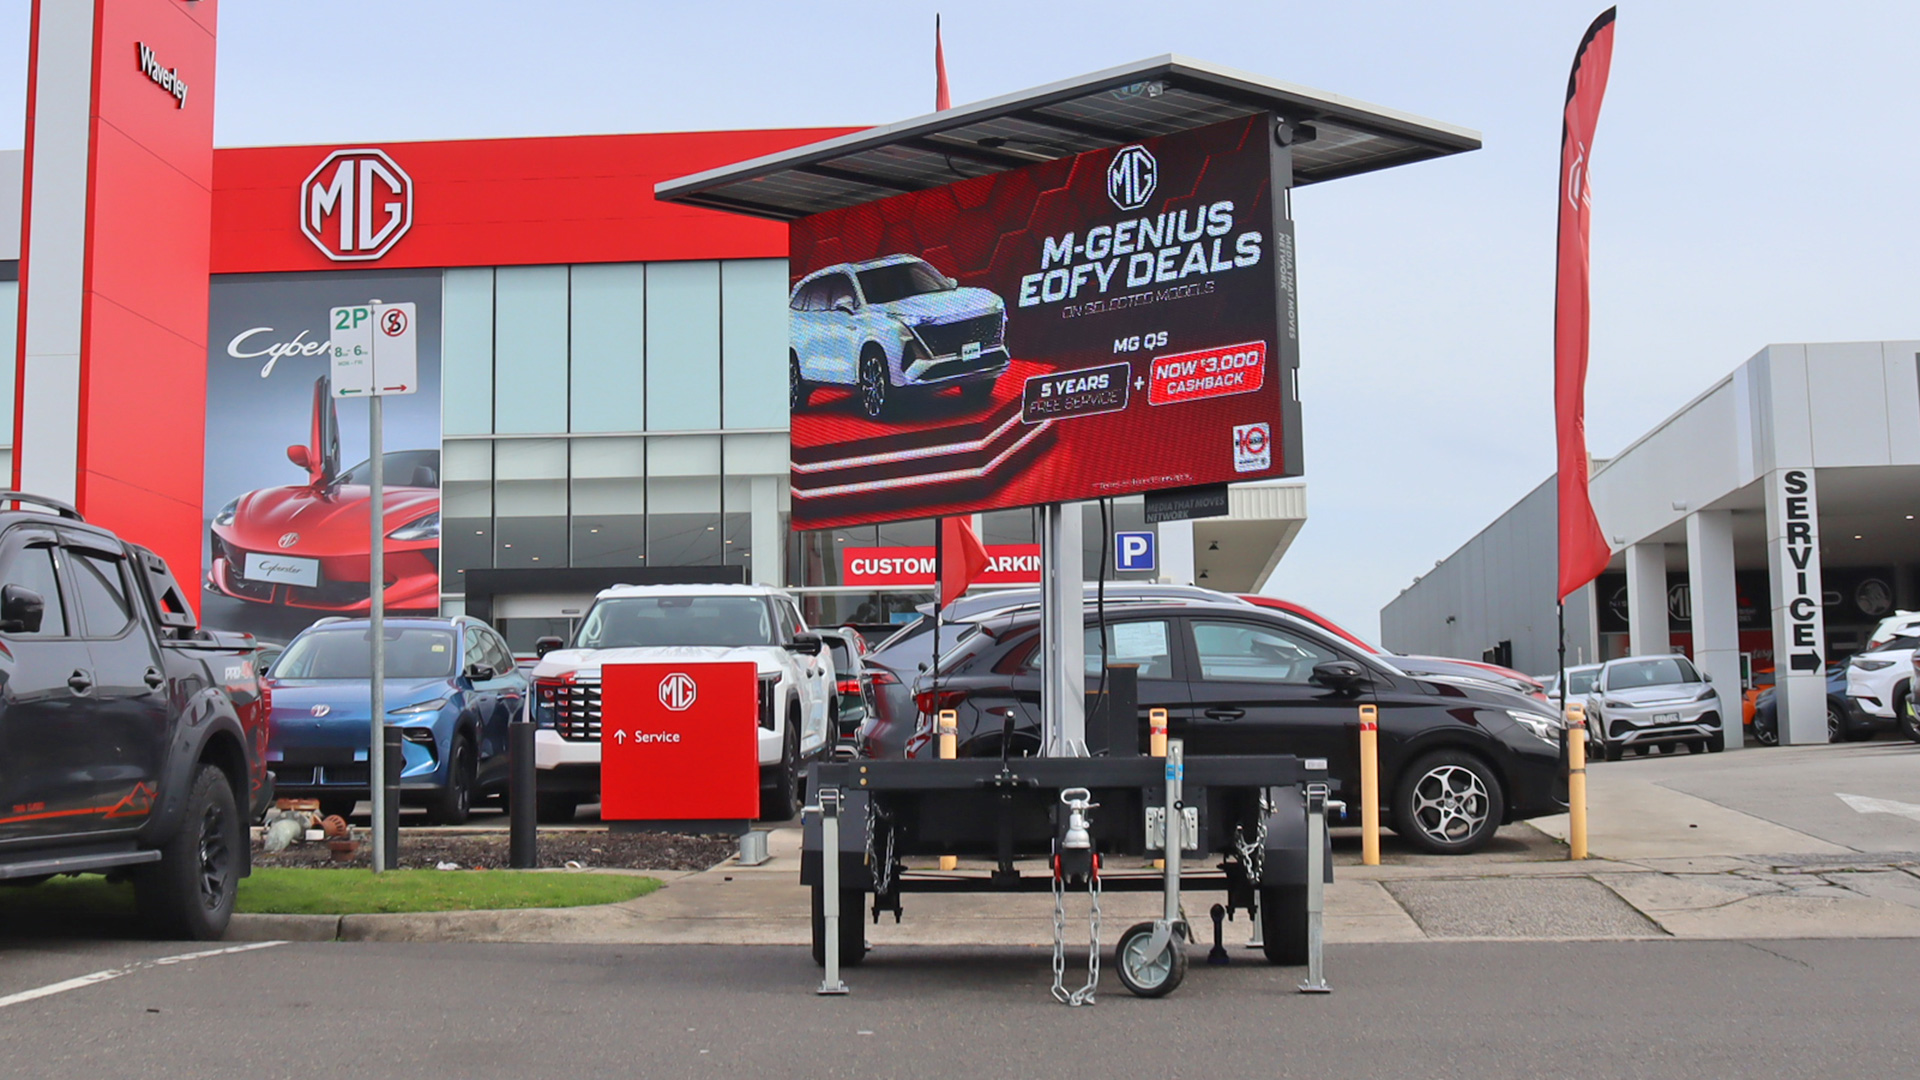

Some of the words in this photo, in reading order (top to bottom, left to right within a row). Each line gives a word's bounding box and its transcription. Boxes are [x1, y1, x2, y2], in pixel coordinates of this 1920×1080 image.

[138, 41, 189, 109] Waverley
[1111, 148, 1154, 206] MG
[310, 158, 403, 252] MG
[1040, 200, 1235, 269] M-GENIUS
[1018, 256, 1121, 308] EOFY
[1126, 230, 1263, 288] DEALS
[1278, 232, 1287, 289] NETWORK
[1062, 306, 1082, 319] ON
[1084, 292, 1153, 316] SELECTED
[1155, 281, 1215, 301] MODELS
[335, 308, 368, 330] 2P
[1288, 300, 1296, 339] MOVES
[226, 326, 331, 378] Cyber
[1113, 336, 1140, 354] MG
[1143, 331, 1169, 351] QS
[1156, 360, 1197, 380] NOW
[1201, 350, 1259, 373] $3,000
[1041, 382, 1052, 398] 5
[1056, 374, 1110, 395] YEARS
[1167, 371, 1245, 395] CASHBACK
[1029, 399, 1061, 414] FREE
[1064, 390, 1119, 410] SERVICE
[1147, 510, 1189, 523] NETWORK
[851, 558, 937, 575] CUSTOM
[984, 555, 1041, 572] ARKIN
[1123, 536, 1148, 566] P
[1784, 470, 1816, 647] SERVICE
[661, 675, 694, 708] MG
[634, 730, 681, 743] Service
